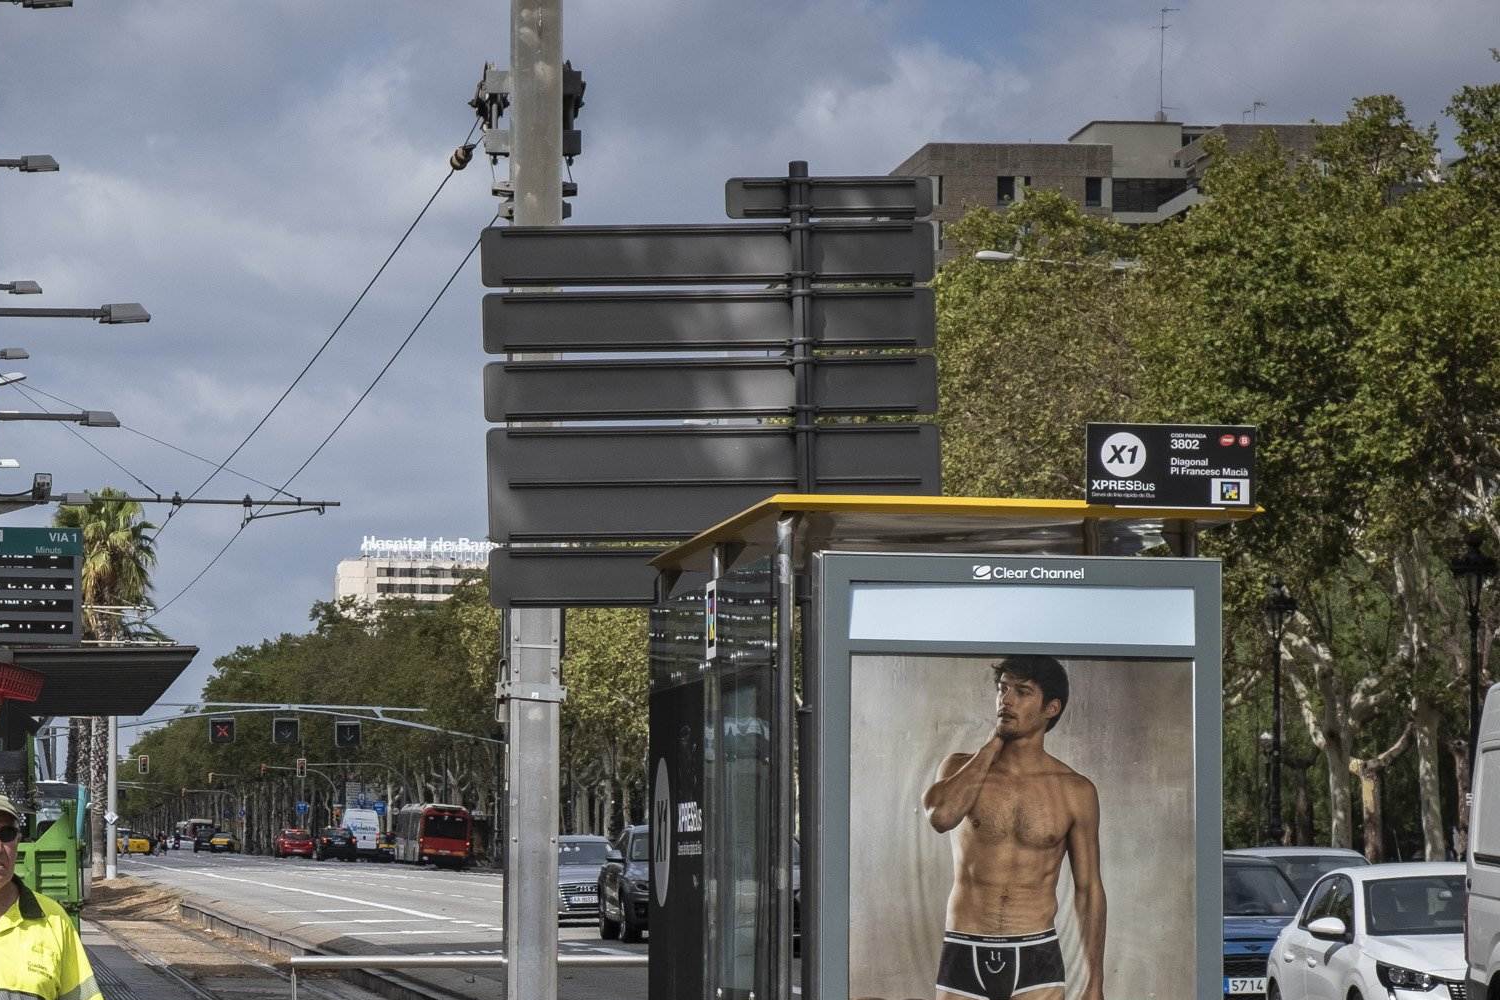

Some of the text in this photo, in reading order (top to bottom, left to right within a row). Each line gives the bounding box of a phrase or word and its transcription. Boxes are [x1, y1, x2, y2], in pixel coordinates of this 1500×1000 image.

[1171, 439, 1200, 450] 3802
[1107, 444, 1139, 464] X1
[1170, 457, 1209, 468] Diagonal
[1170, 467, 1249, 477] Pl Francesc Macià
[1091, 479, 1156, 491] XPRESBus
[49, 532, 77, 543] VIA 1
[35, 546, 62, 554] Minuts
[361, 535, 427, 553] Hospital
[431, 536, 456, 552] de
[993, 566, 1085, 580] Clear Channel
[655, 799, 668, 863] X1
[1231, 979, 1264, 992] 5714
